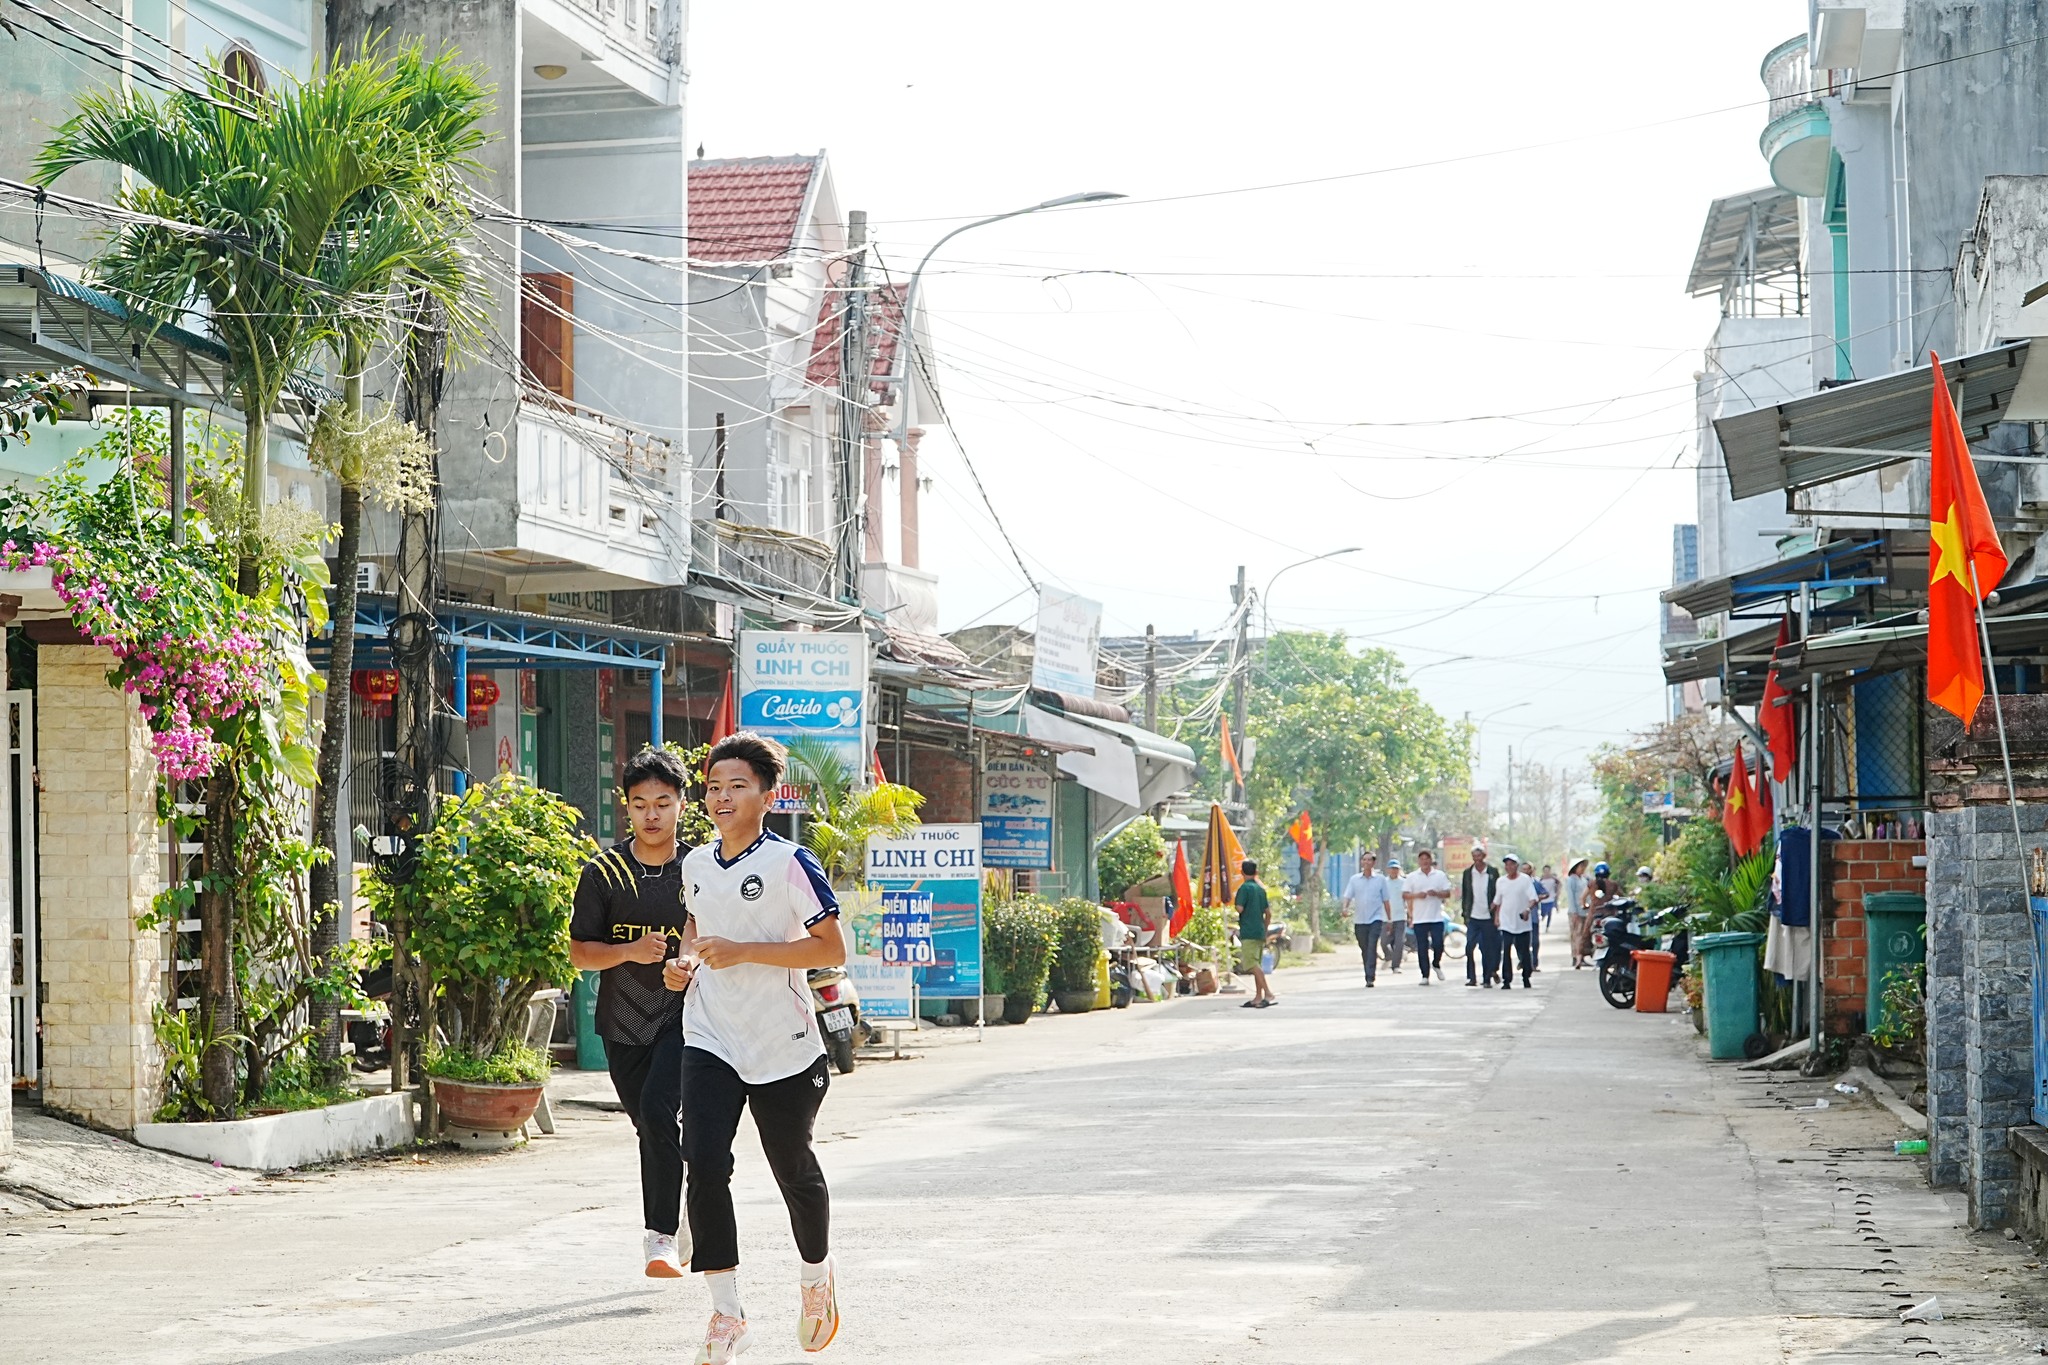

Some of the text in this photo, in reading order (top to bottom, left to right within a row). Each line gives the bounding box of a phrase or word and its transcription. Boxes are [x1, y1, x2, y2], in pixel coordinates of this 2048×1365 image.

[585, 591, 609, 614] CHI
[800, 640, 849, 655] THUỐC
[756, 659, 850, 676] LINH CHI
[761, 695, 822, 719] Calcido
[774, 801, 782, 809] 2
[920, 828, 960, 840] THUỐC
[871, 849, 927, 867] LINH
[934, 849, 975, 867] CHI
[910, 896, 930, 915] BÁN
[883, 917, 904, 938] BẢO
[906, 916, 930, 938] HIỂM
[884, 939, 930, 962] Ô TÔ
